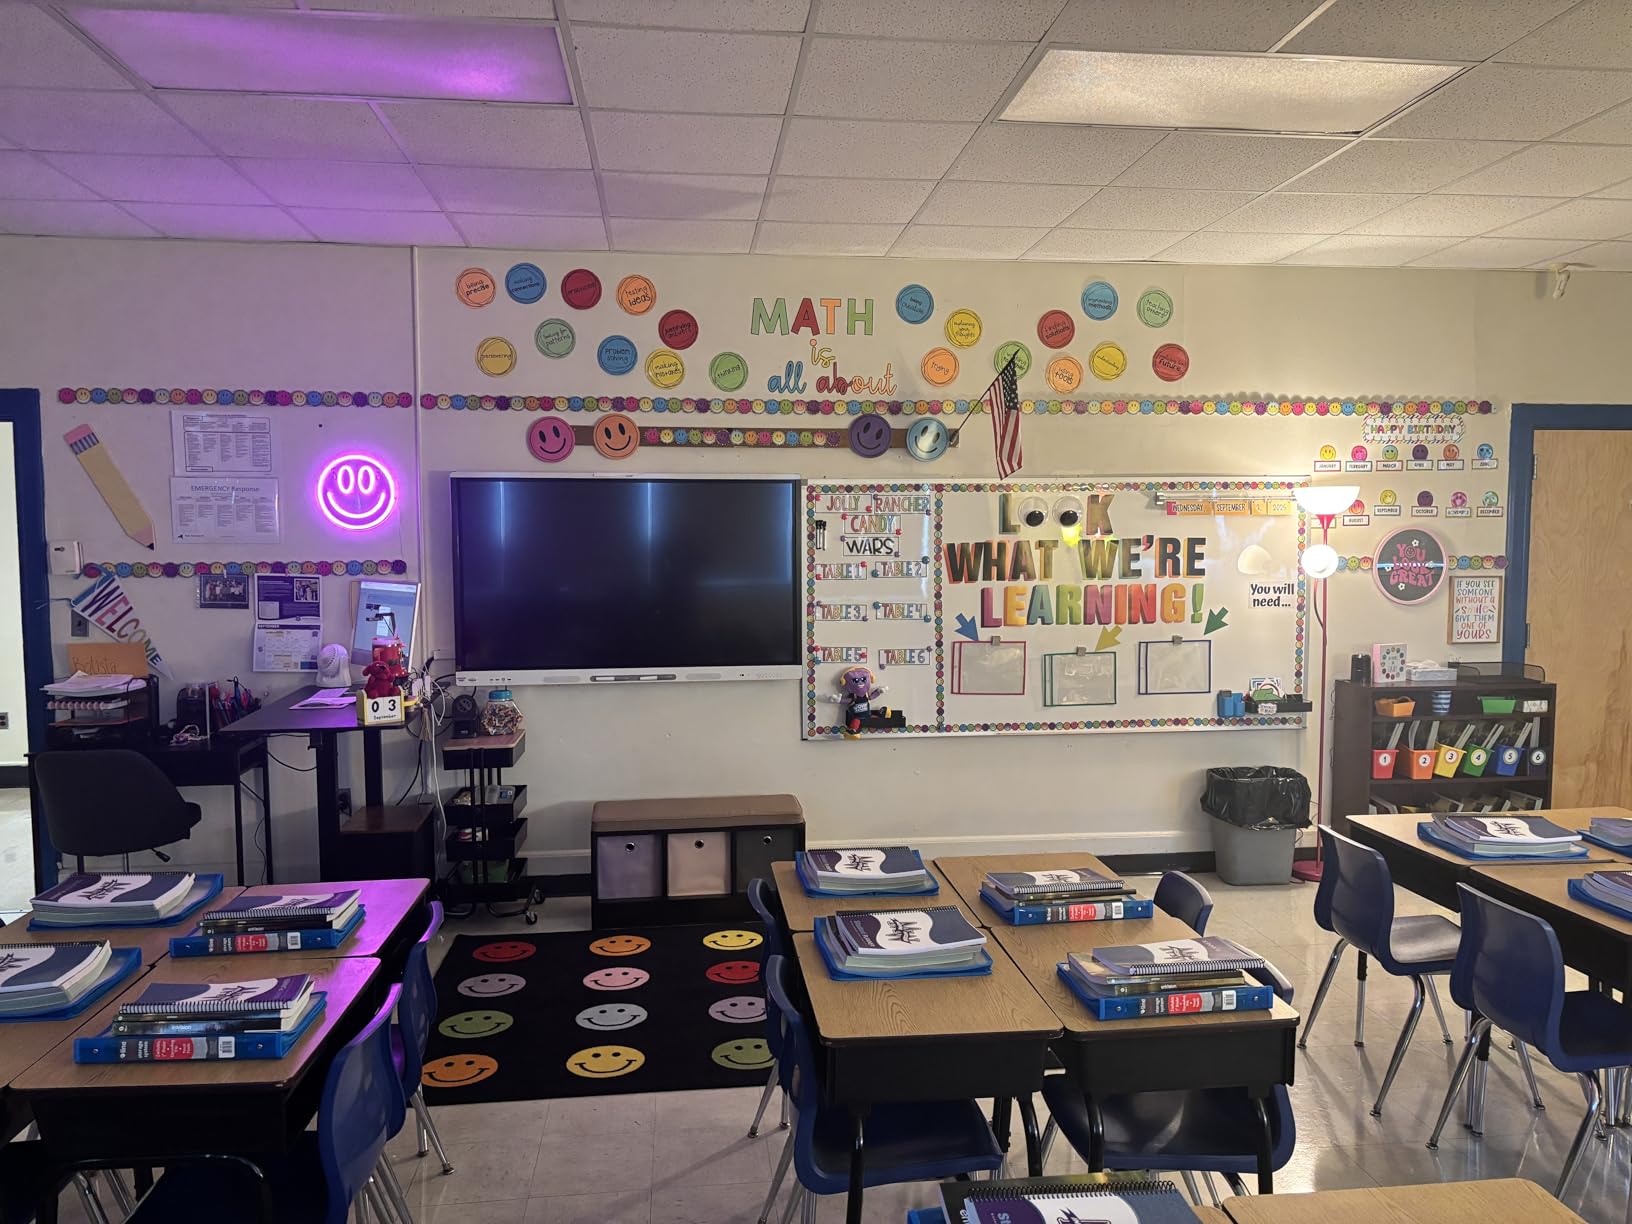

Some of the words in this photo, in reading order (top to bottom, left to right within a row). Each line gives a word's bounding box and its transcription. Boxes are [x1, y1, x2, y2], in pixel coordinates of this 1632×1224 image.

[466, 279, 484, 289] being
[466, 284, 490, 296] precise
[511, 282, 540, 292] connections
[625, 285, 648, 297] testing
[629, 293, 651, 306] ideas
[1146, 299, 1170, 316] teaching
[751, 298, 874, 336] MATH
[1044, 321, 1066, 332] finding
[1045, 325, 1070, 340] solutions
[545, 334, 571, 346] patterns
[605, 347, 630, 355] problem
[810, 339, 835, 368] is
[607, 355, 629, 364] solving
[655, 361, 679, 370] making
[655, 367, 682, 378] mistakes
[717, 363, 741, 378] thinking
[931, 362, 950, 375] trying
[768, 361, 807, 394] all
[816, 362, 897, 396] about
[1054, 371, 1073, 385] tools
[1370, 425, 1404, 434] HAPPY
[1407, 425, 1456, 434] BIRTHDAY
[231, 485, 260, 494] Response
[827, 496, 860, 511] JOLLY
[875, 496, 930, 512] RANCHER
[1216, 503, 1246, 512] SEPTEMBER
[851, 515, 895, 532] CANDY
[846, 538, 894, 555] WARS
[1396, 543, 1426, 561] YOU
[943, 539, 1059, 584] WHAT
[821, 564, 852, 578] TABLE
[854, 564, 861, 578] 1
[881, 561, 912, 576] TABLE
[914, 562, 922, 577] 2
[1390, 571, 1434, 587] GREAT
[1456, 580, 1463, 588] IF
[1483, 580, 1495, 588] SEE
[1250, 584, 1271, 595] You
[1272, 583, 1295, 595] will
[1457, 588, 1495, 596] SOMEONE
[981, 583, 1205, 628] LEARNING!
[1252, 596, 1291, 607] need...
[1456, 596, 1488, 604] WITHOUT
[820, 605, 851, 619] TABLE
[854, 605, 861, 619] 3
[882, 603, 913, 619] TABLE
[915, 603, 922, 618] 4
[1461, 605, 1488, 614] smile
[80, 577, 162, 666] WELCOME
[1455, 615, 1471, 623] GIVE
[1473, 614, 1495, 623] THEM
[1461, 622, 1476, 630] ONE
[1478, 622, 1487, 630] OF
[1456, 630, 1492, 640] YOURS
[821, 647, 851, 661] TABLE
[854, 647, 862, 661] 5
[884, 649, 915, 664] TABLE
[917, 649, 926, 664] 6
[372, 701, 379, 712] 0
[388, 700, 396, 711] 3
